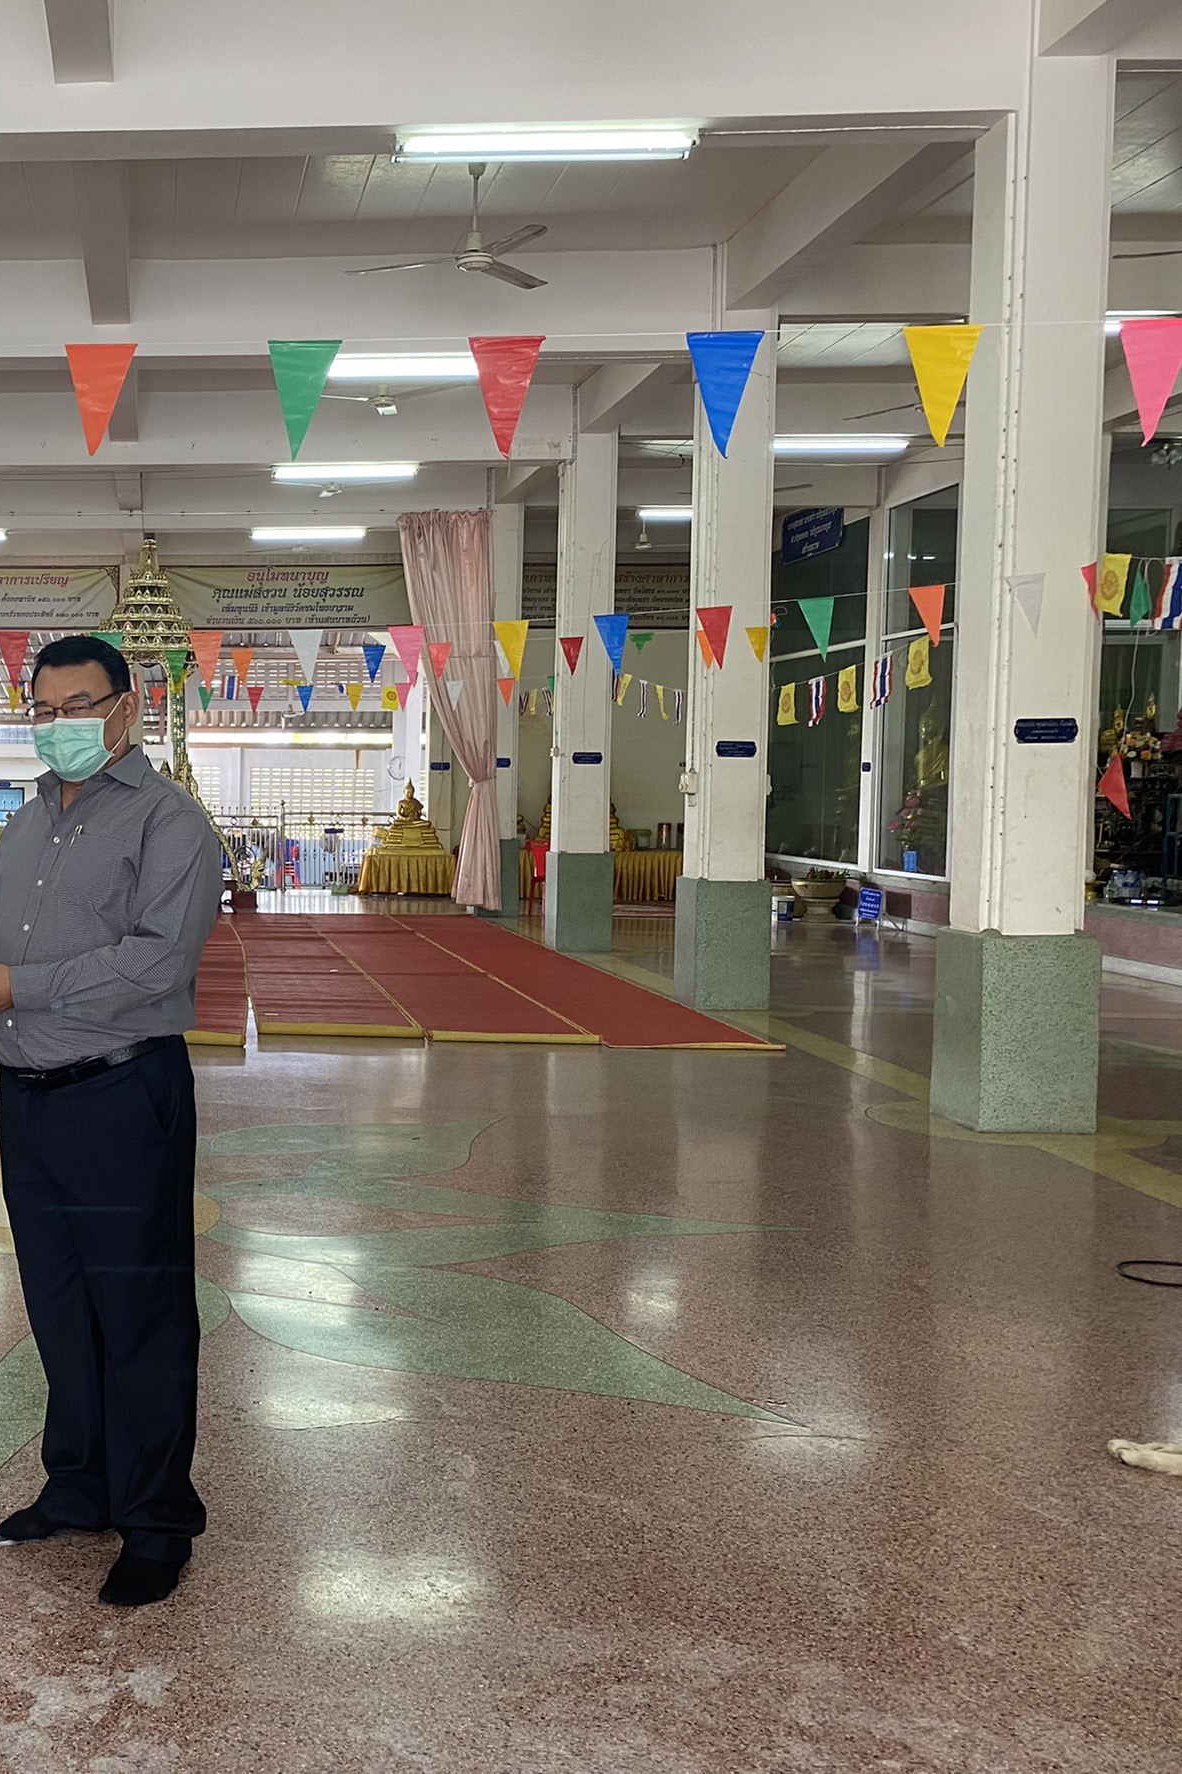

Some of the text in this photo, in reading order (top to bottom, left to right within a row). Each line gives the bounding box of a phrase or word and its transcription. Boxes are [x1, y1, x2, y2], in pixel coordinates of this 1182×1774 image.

[246, 565, 329, 586] อนุโมทนาบุญ
[212, 582, 365, 603] คุณแม่สงวน น้อยสุวรรณ
